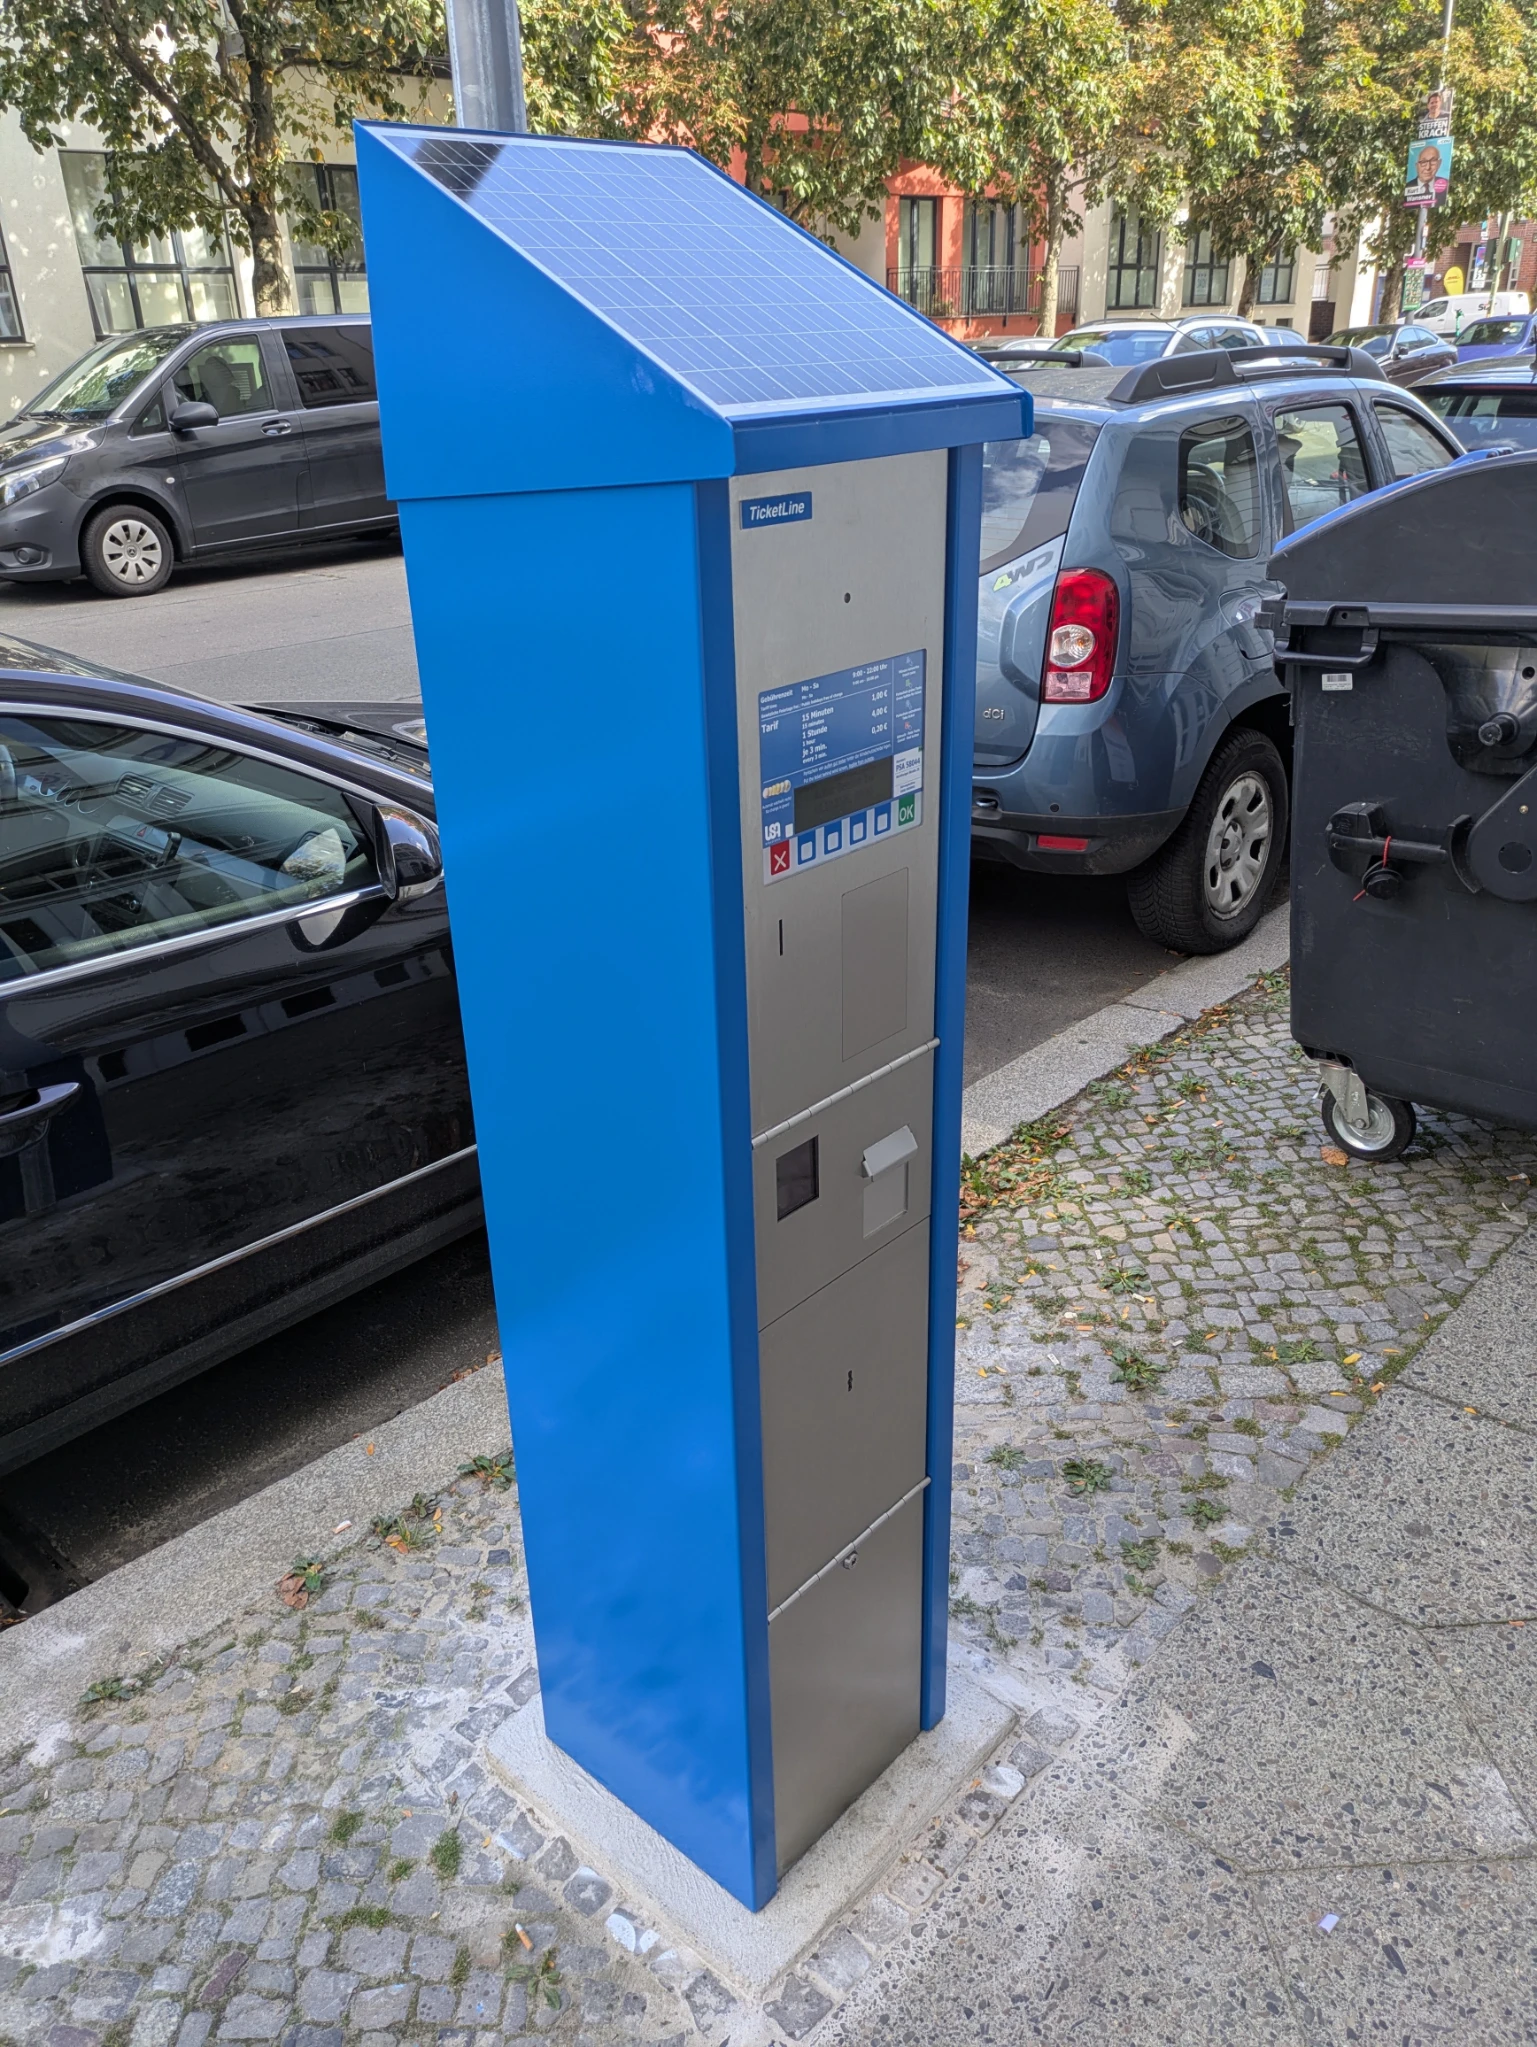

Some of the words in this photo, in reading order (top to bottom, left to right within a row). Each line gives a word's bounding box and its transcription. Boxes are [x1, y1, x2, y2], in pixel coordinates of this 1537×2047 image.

[1419, 121, 1448, 130] STEFFEN
[1418, 128, 1446, 139] KRACH
[750, 500, 804, 520] TicketLine
[760, 690, 793, 704] Gebührenzeit
[762, 721, 779, 734] Tarif
[802, 714, 809, 722] 15
[811, 706, 834, 719] Minuten
[872, 692, 883, 702] 1,00
[982, 708, 1004, 720] dCi
[808, 725, 828, 738] Stunde
[872, 708, 883, 718] 4,00
[802, 748, 808, 758] je
[815, 742, 827, 752] min.
[872, 724, 883, 735] 0,20
[803, 757, 814, 765] every
[896, 763, 905, 772] PSA
[900, 804, 914, 822] OK
